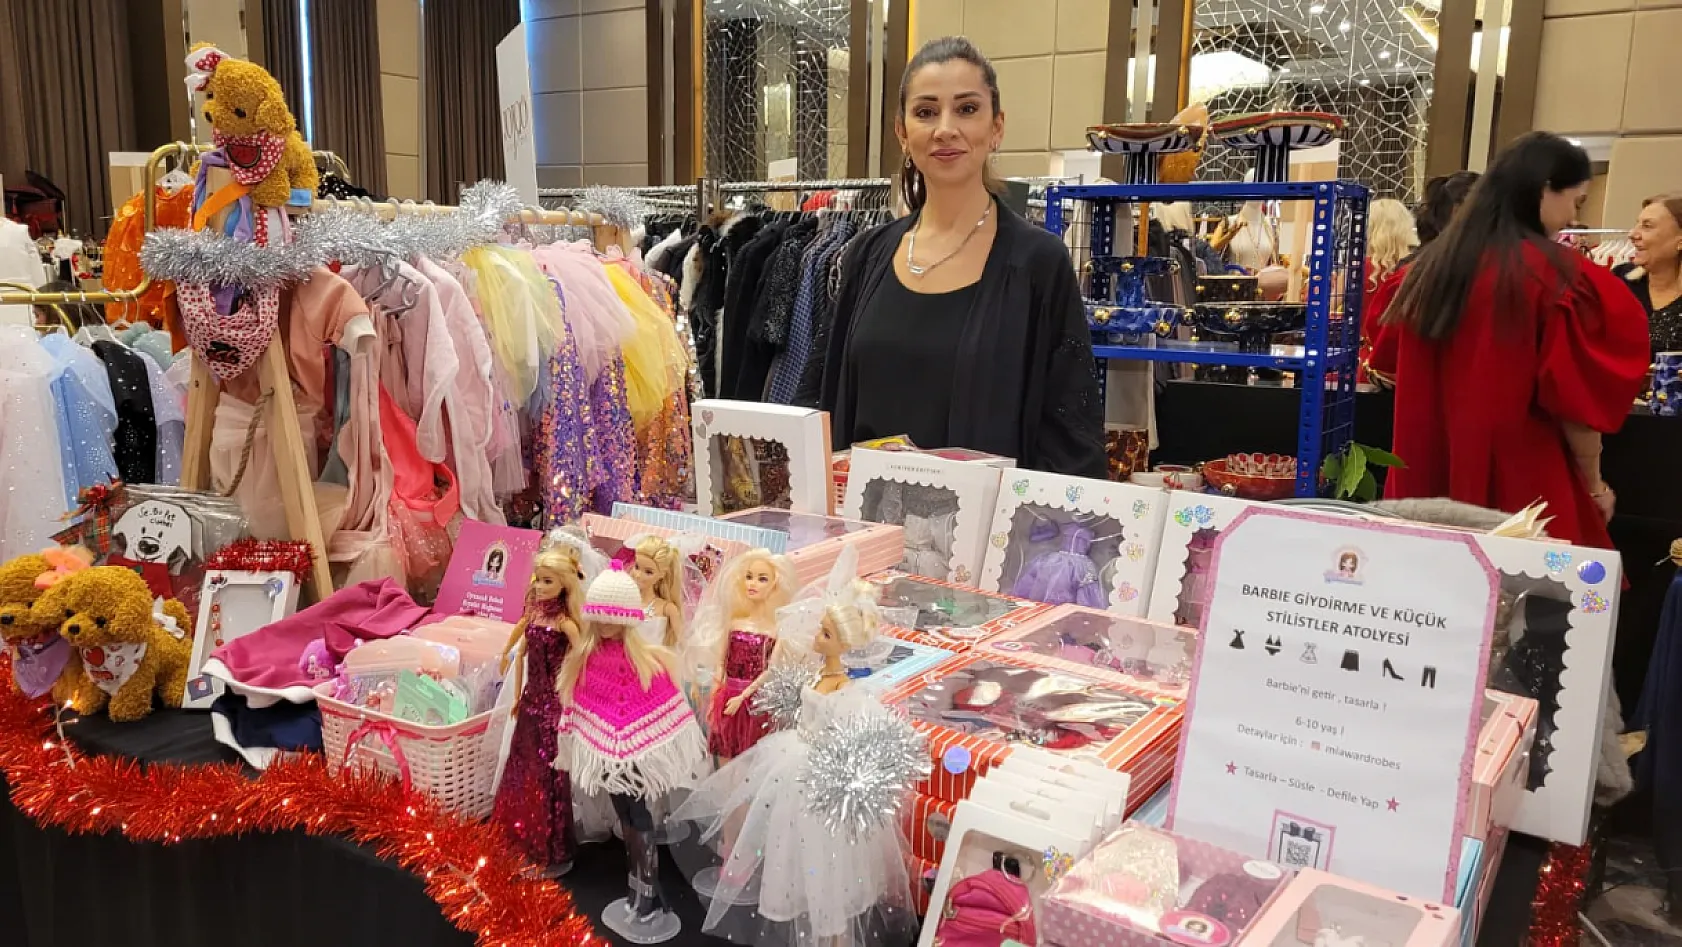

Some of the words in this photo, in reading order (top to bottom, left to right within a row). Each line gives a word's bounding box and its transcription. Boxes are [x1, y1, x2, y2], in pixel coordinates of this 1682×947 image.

[1242, 583, 1291, 603] BARBIE
[1293, 591, 1366, 615] GİYDİRME
[1370, 605, 1390, 619] VE
[1393, 608, 1447, 629] KÜÇÜK
[1266, 610, 1339, 634] STİLİSTLER
[1342, 623, 1411, 647] ATOLYESİ
[1265, 677, 1310, 696] Barbie'ni
[1311, 689, 1337, 701] getir
[1344, 695, 1380, 711] tasarla
[1294, 715, 1319, 730] 6-10
[1237, 723, 1277, 741] Detaylar
[1279, 732, 1298, 746] için
[1325, 744, 1401, 771] miawardrobes
[1244, 765, 1278, 784] Tasarla
[1288, 777, 1316, 792] Süsle
[1326, 786, 1358, 804] Defile
[1360, 795, 1379, 810] Yap
